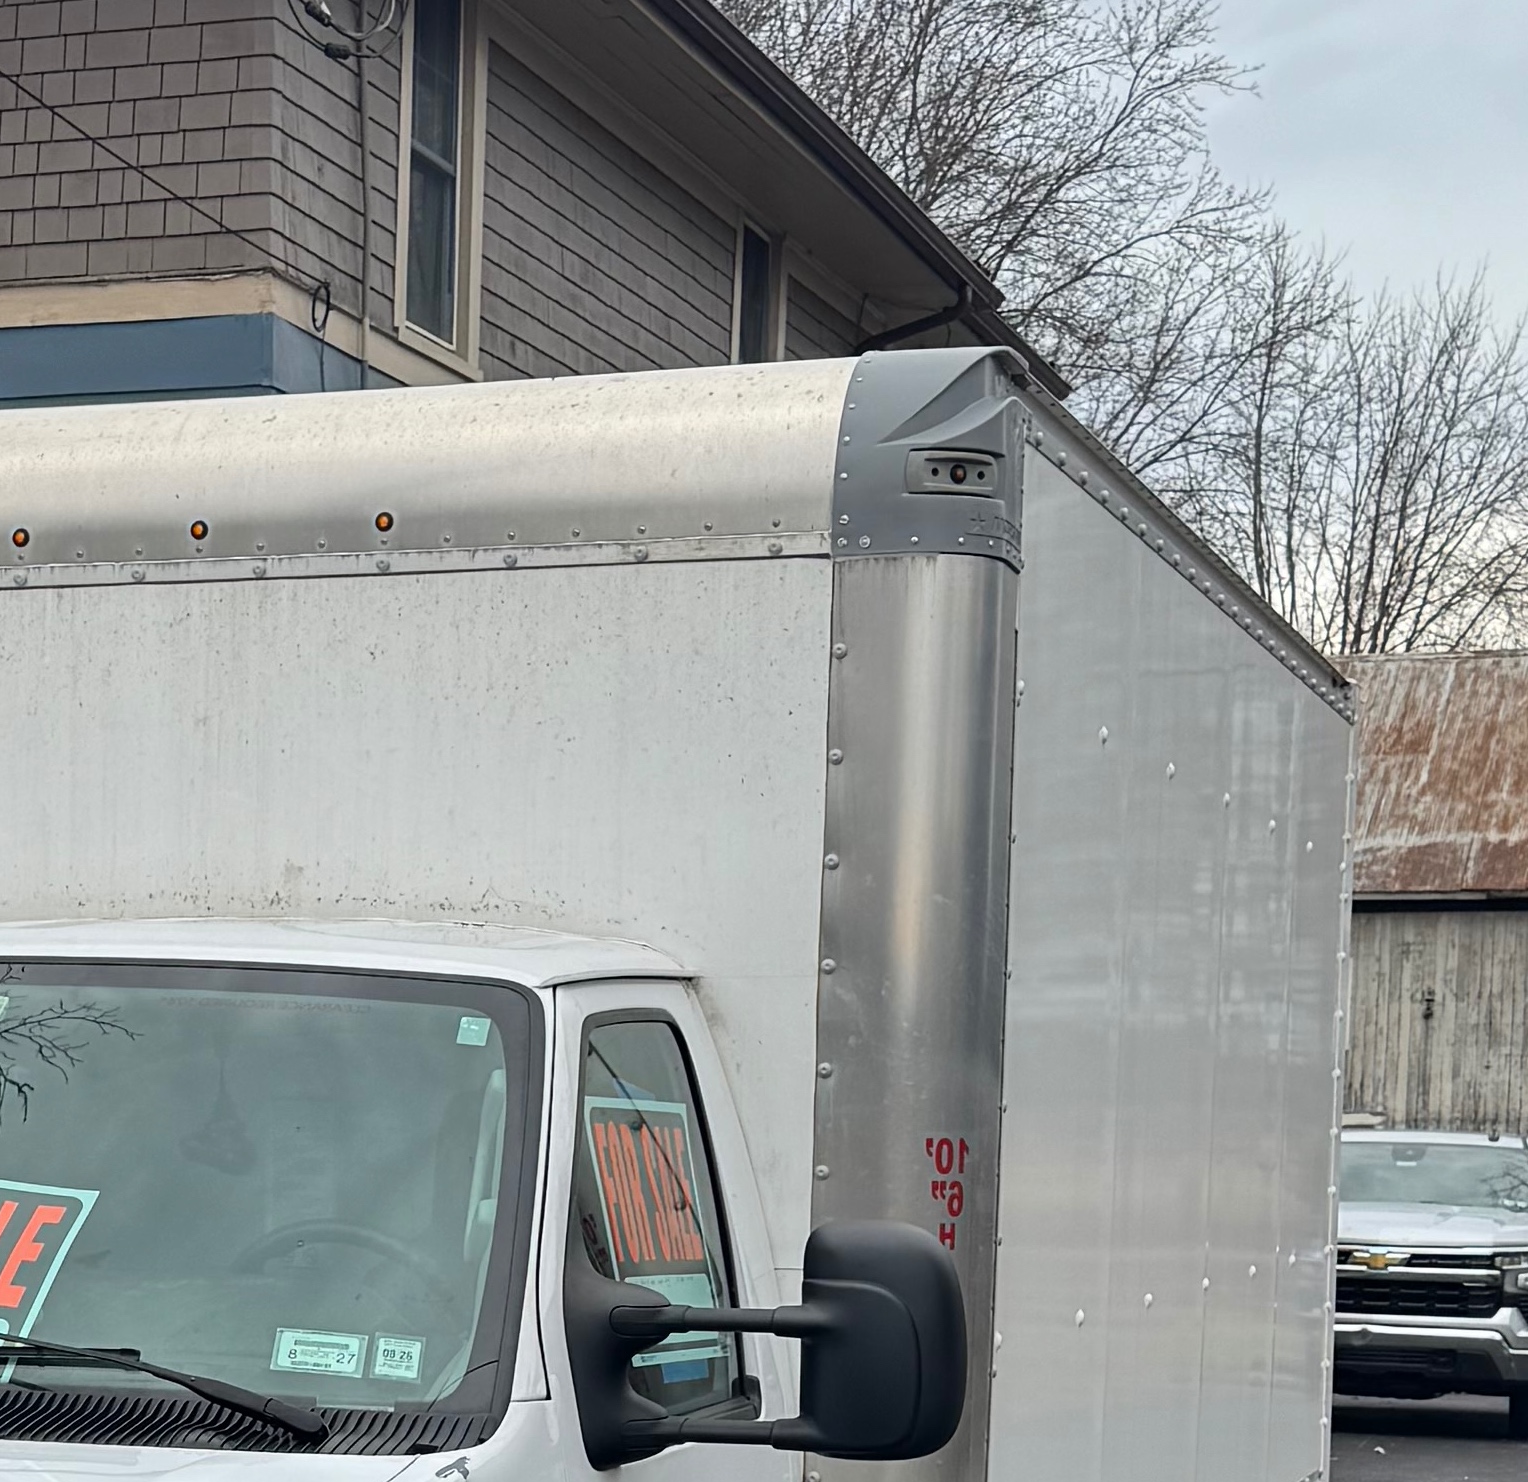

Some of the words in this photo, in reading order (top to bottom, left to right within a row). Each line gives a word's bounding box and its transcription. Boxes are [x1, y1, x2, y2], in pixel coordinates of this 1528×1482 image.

[594, 1120, 656, 1264] FOR
[287, 1347, 298, 1360] 8
[336, 1352, 357, 1365] 27
